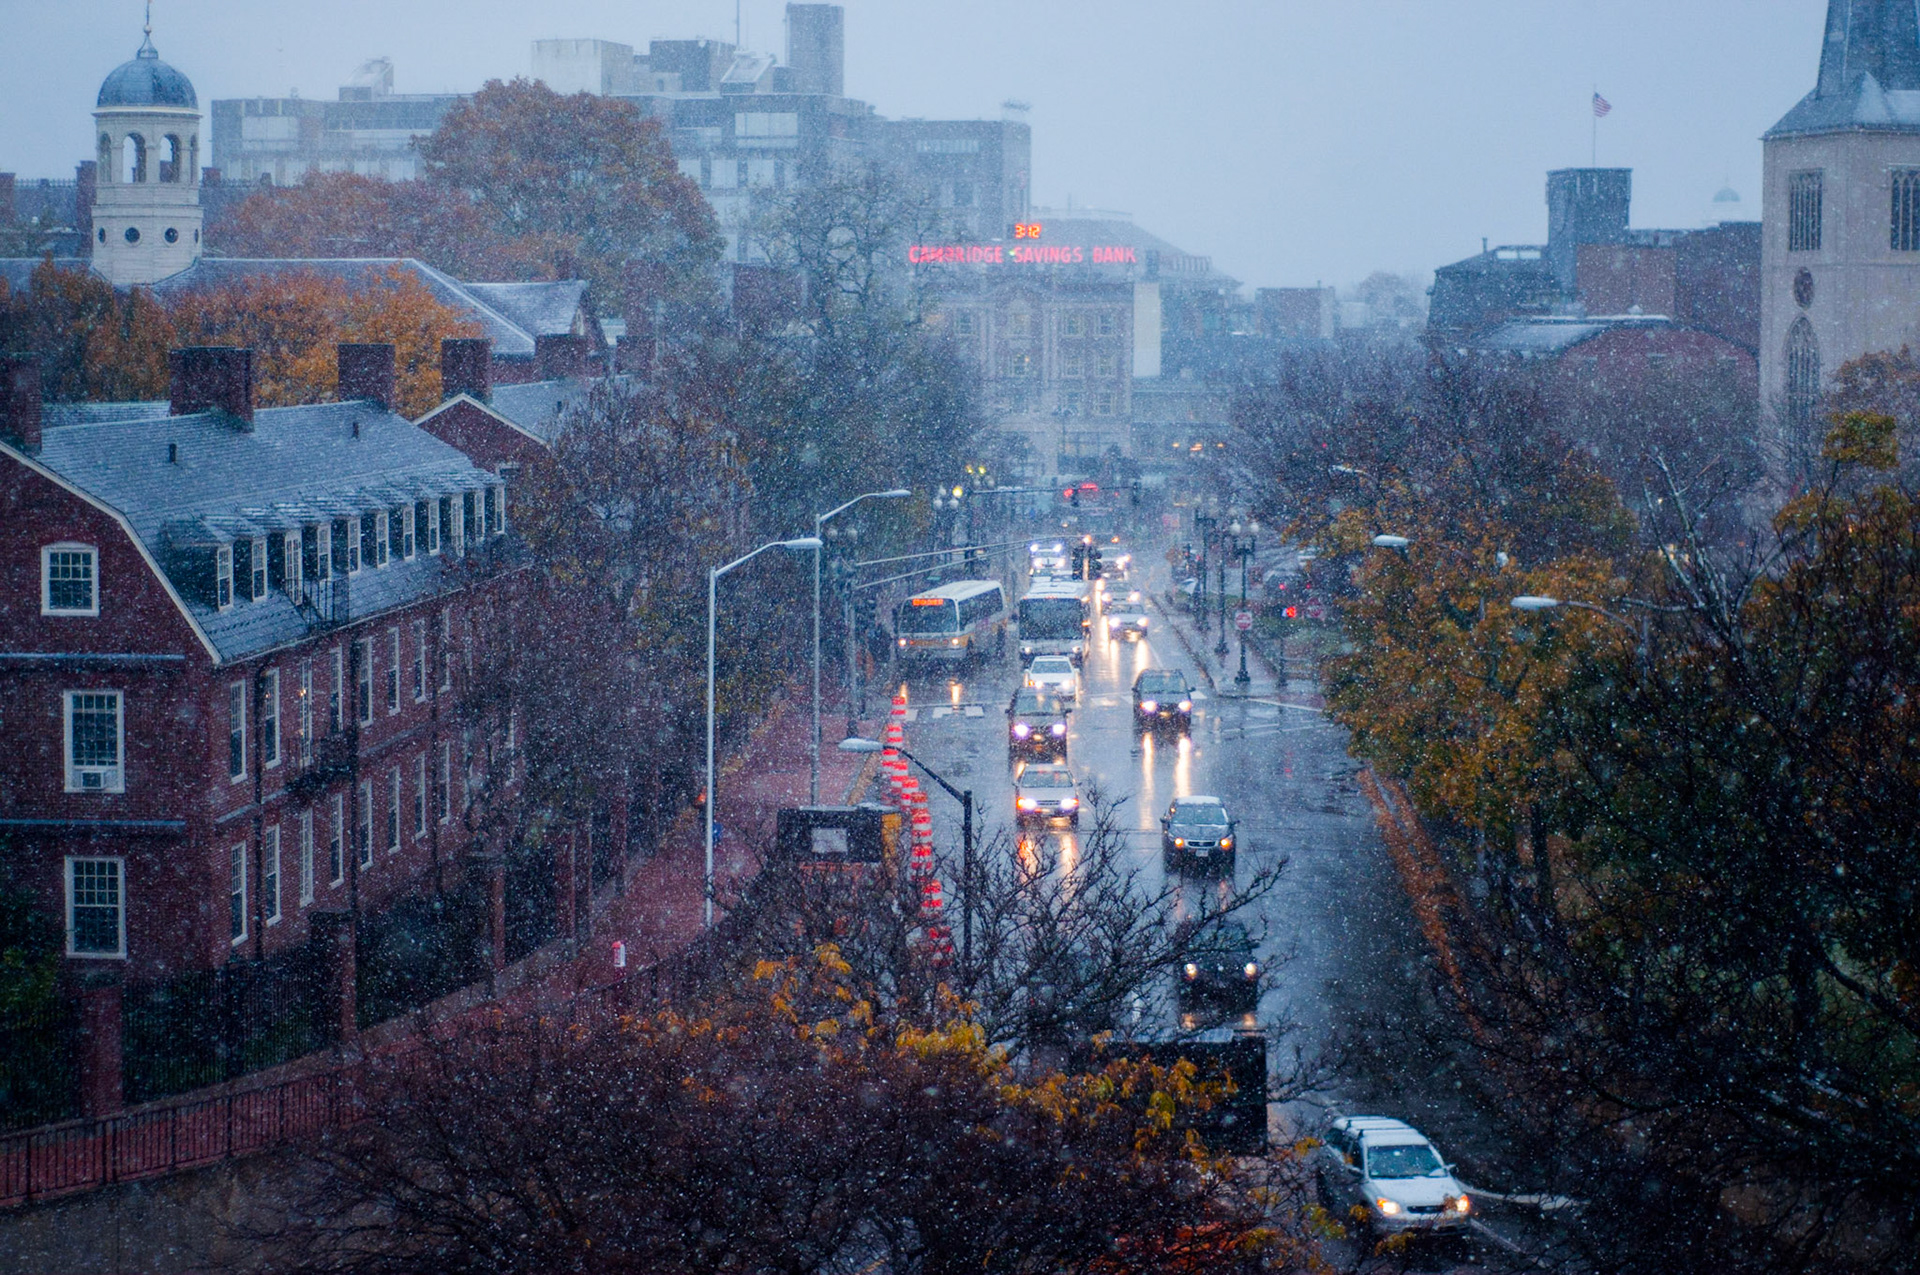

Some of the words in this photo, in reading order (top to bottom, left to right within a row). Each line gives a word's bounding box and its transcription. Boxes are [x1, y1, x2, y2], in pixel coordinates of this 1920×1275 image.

[908, 245, 1003, 264] CAMBRIDGE
[1013, 246, 1083, 264] SAVINGS
[1093, 247, 1136, 264] BANK
